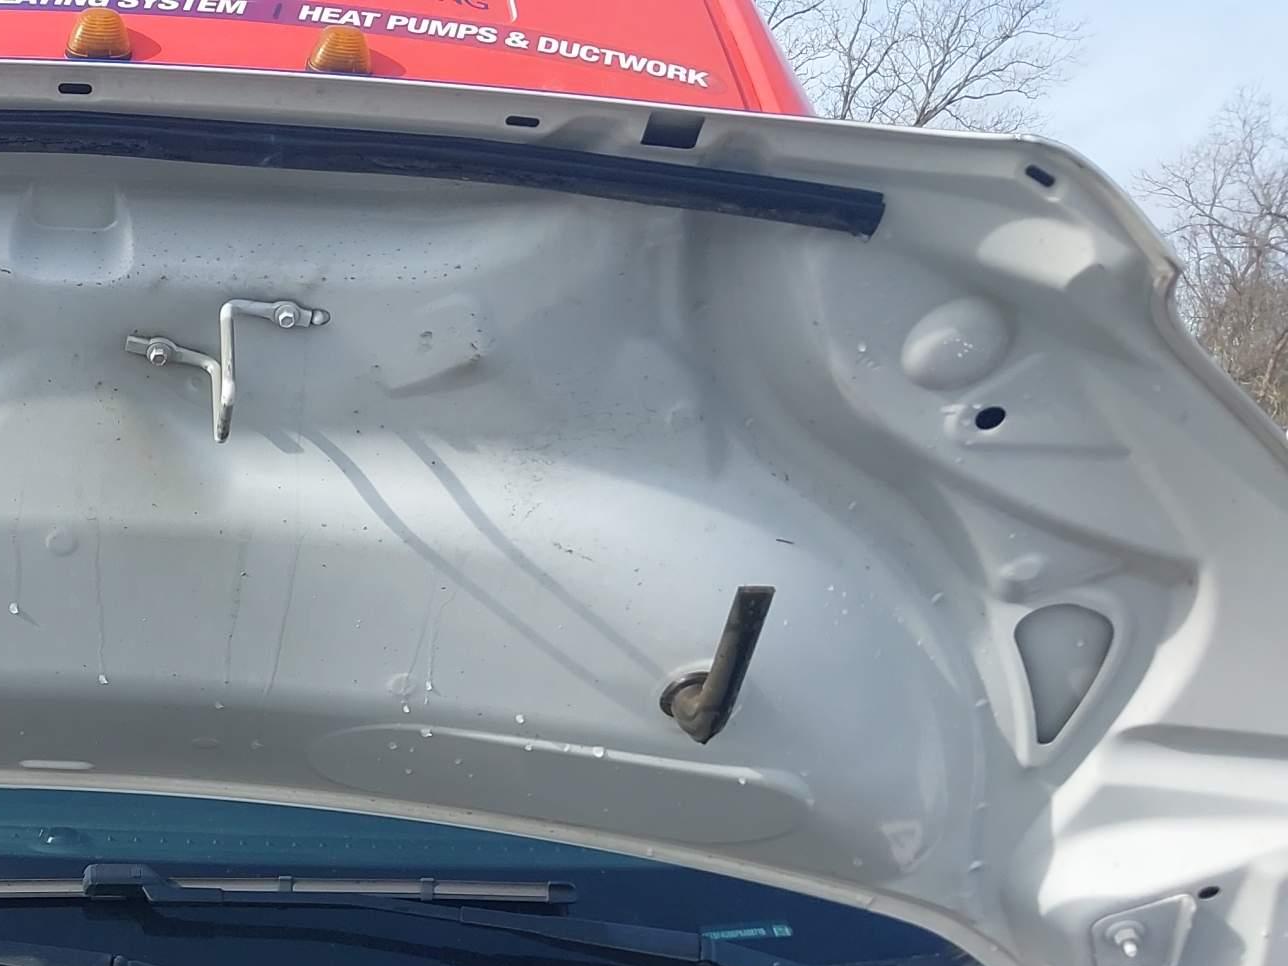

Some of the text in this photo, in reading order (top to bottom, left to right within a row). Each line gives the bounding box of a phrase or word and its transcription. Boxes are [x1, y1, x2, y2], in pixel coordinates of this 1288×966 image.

[117, 0, 248, 14] SYSTEM
[298, 5, 711, 88] HEAT PUMPS & DUCTWORK
